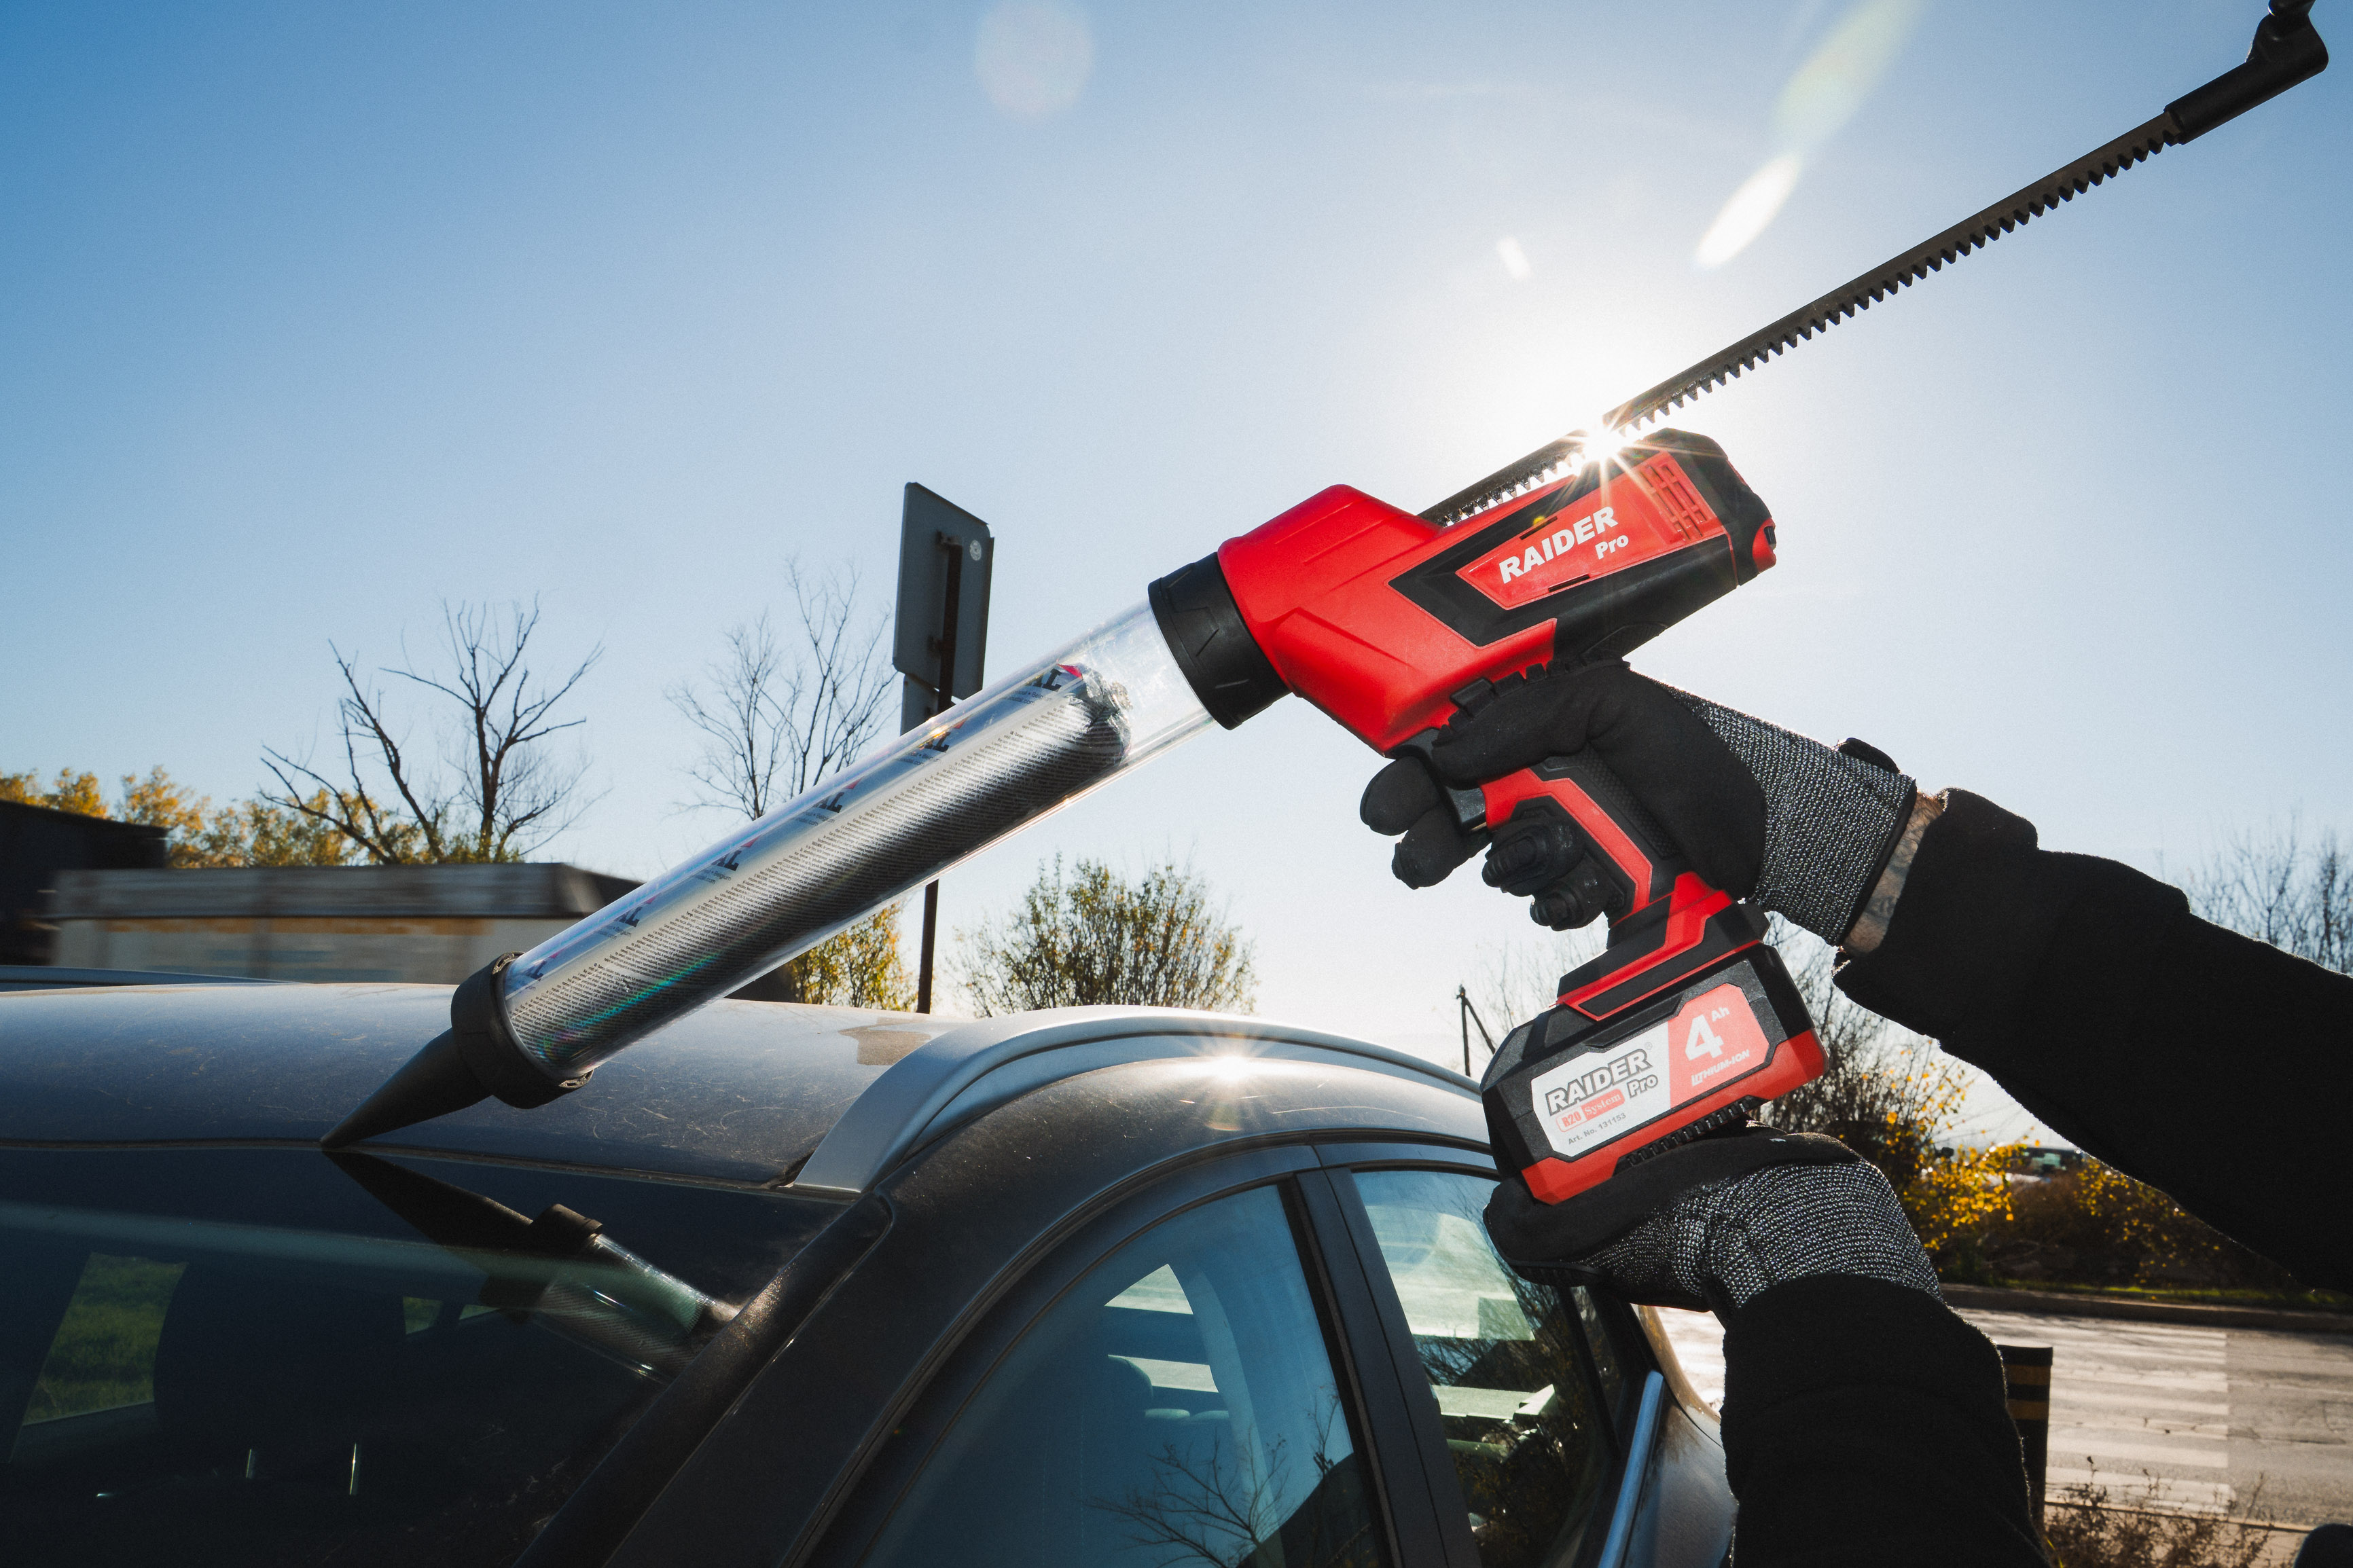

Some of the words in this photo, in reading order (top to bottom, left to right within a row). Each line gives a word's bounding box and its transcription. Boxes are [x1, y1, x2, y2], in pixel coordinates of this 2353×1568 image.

[1498, 506, 1618, 583] RAIDER
[1595, 534, 1629, 560] Pro
[1685, 1014, 1724, 1061] 4
[1711, 1006, 1730, 1022] Ah
[1545, 1049, 1653, 1116] RAIDER
[1627, 1074, 1658, 1098] Pro
[1691, 1049, 1750, 1087] LITHIUM-ION
[1561, 1112, 1582, 1127] R20
[1584, 1093, 1621, 1116] System
[1568, 1134, 1583, 1145] Art.
[1583, 1128, 1597, 1137] No.
[1598, 1112, 1627, 1130] 131153
